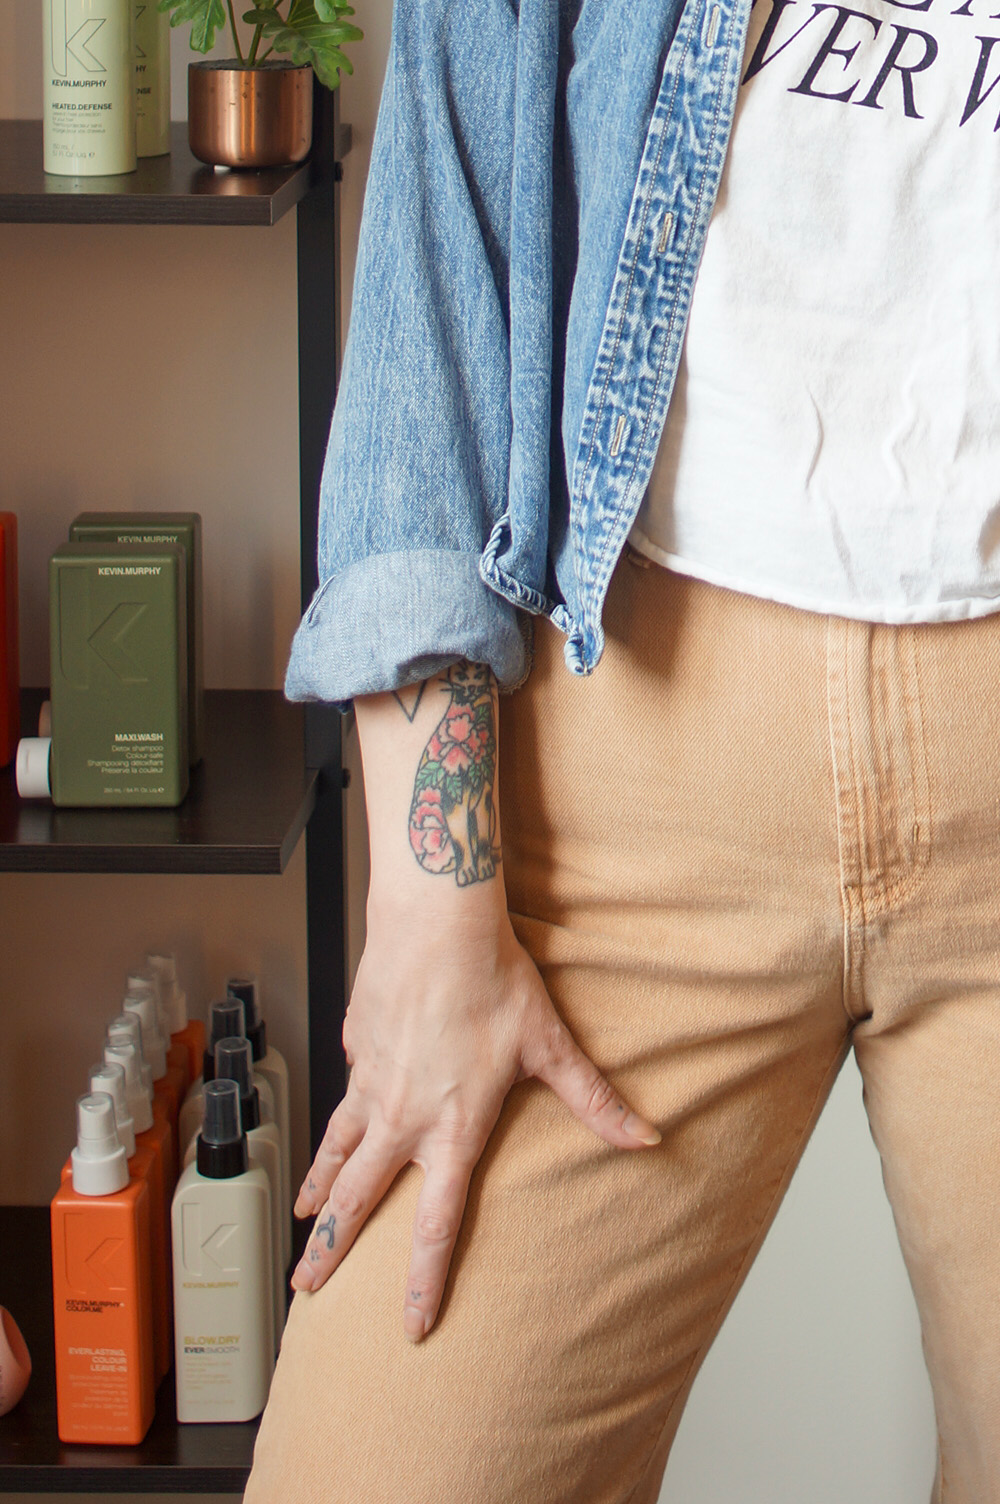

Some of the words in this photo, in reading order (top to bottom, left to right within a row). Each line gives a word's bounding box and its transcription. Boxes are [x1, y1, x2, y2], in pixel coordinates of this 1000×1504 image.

[51, 79, 108, 88] KEVIN.MURPHY
[51, 102, 113, 111] HEATED.DEFENSE
[116, 535, 178, 544] KEVIN.MURPHY
[97, 566, 162, 576] KEVIN.MURPHY
[114, 732, 164, 742] MAXI.WASH
[65, 1299, 120, 1308] KEVIN.MURPHY
[183, 1335, 241, 1345] BLOW.DRY
[91, 1355, 128, 1365] COLOUR
